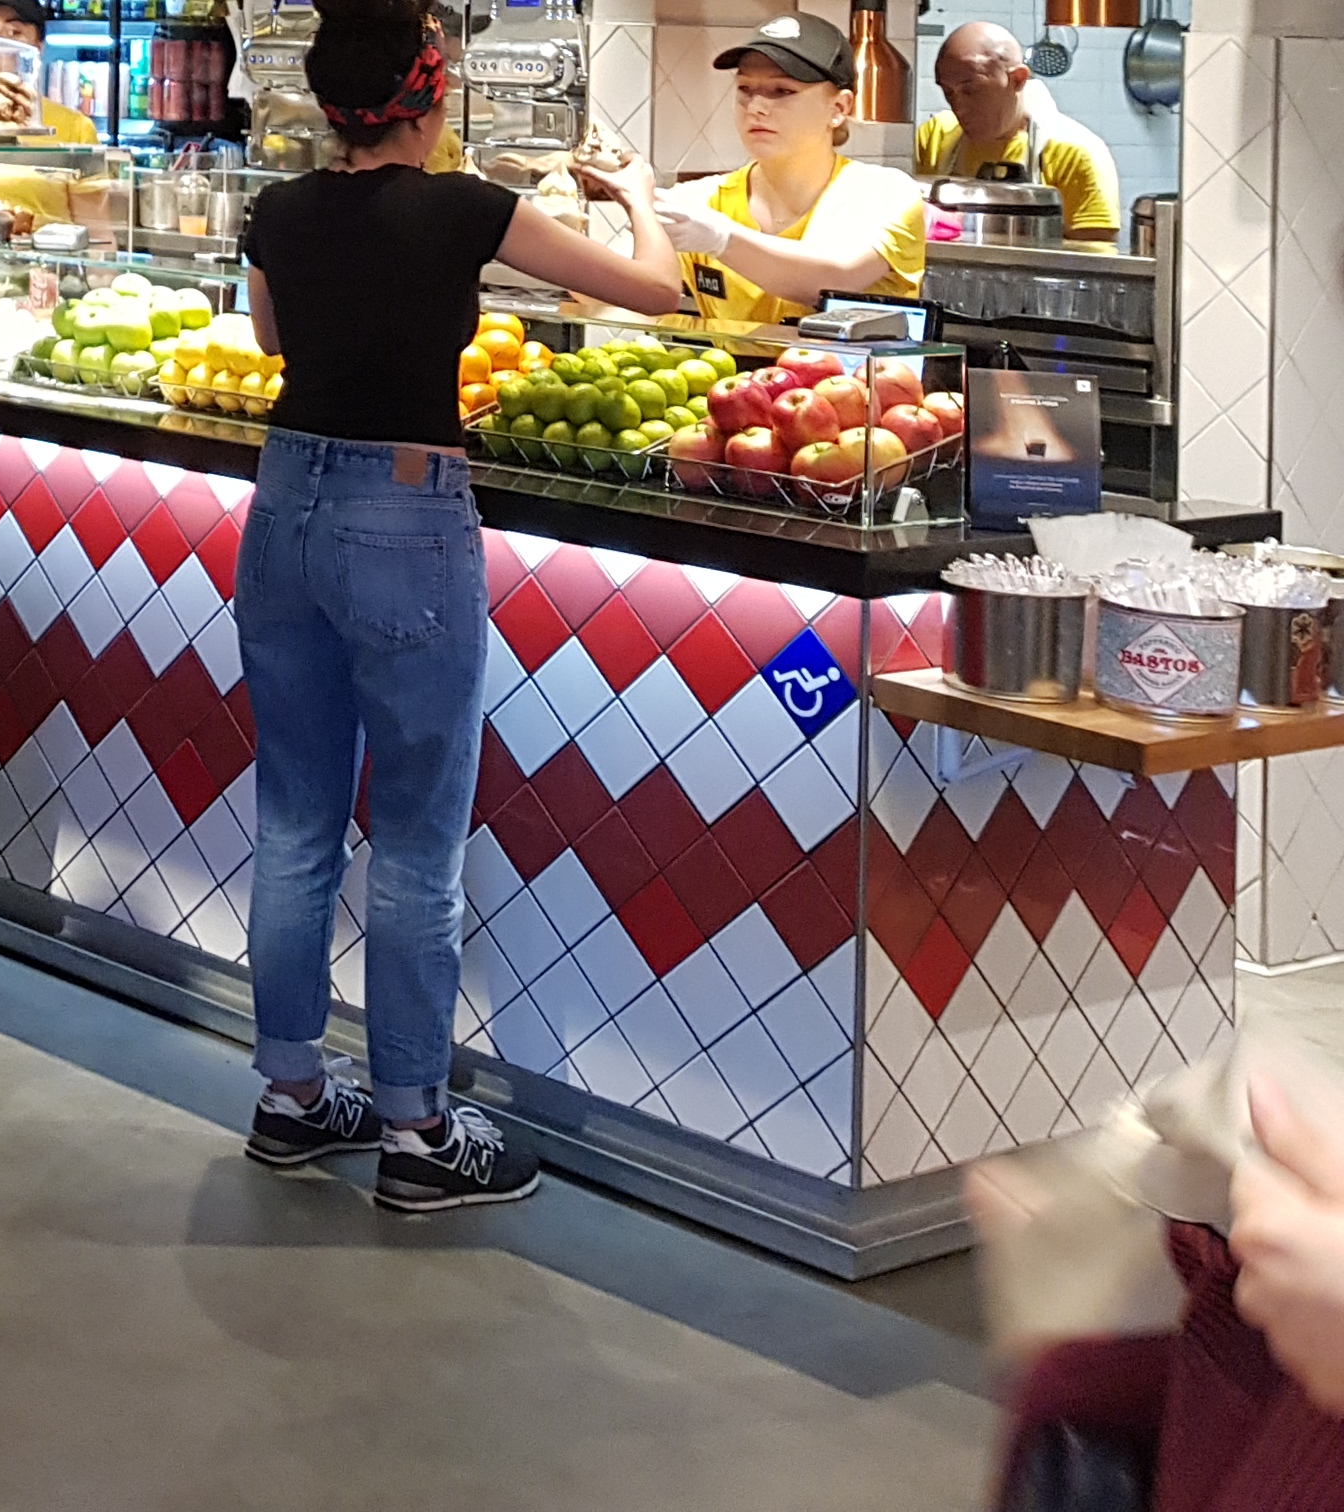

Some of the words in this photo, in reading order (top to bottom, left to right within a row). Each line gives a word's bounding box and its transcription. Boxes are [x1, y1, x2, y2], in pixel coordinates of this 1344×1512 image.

[697, 270, 720, 293] Ana
[1119, 648, 1201, 675] BASTOS
[330, 1095, 364, 1139] N
[460, 1140, 495, 1186] N
